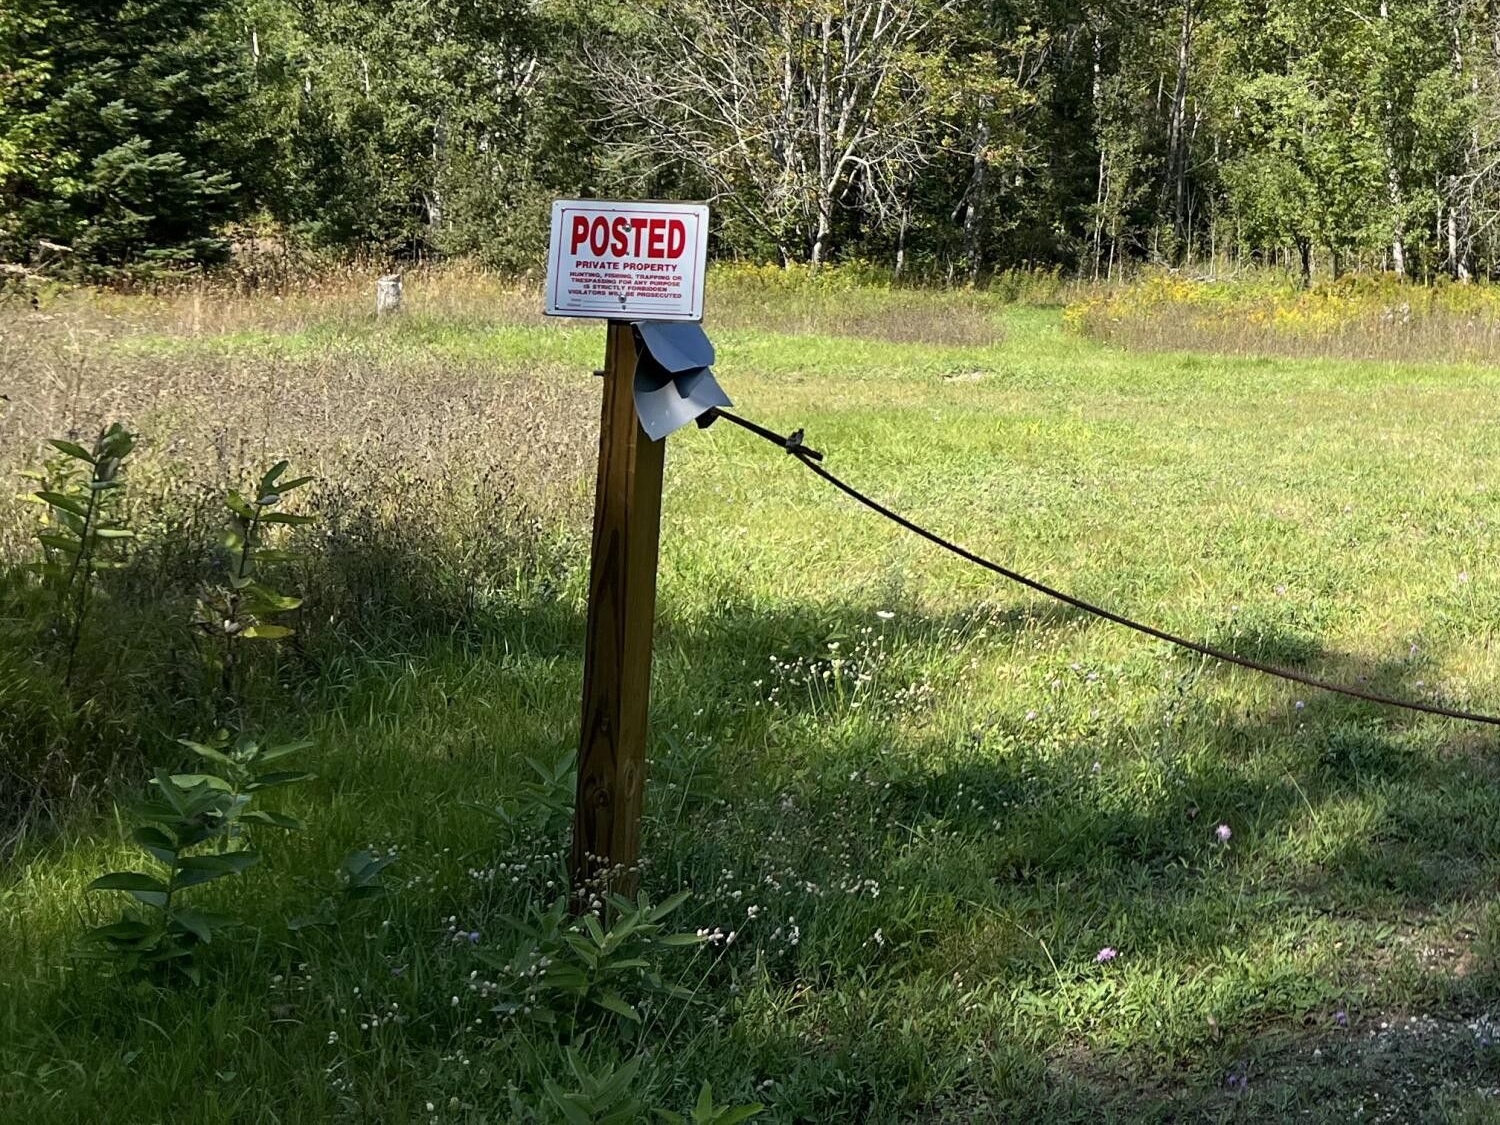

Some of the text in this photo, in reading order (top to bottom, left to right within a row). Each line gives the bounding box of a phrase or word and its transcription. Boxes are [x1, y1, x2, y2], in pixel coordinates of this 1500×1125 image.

[570, 215, 686, 259] POSTED
[575, 260, 678, 272] PRIVATE PROPERTY
[571, 277, 617, 285] TRESPASSING
